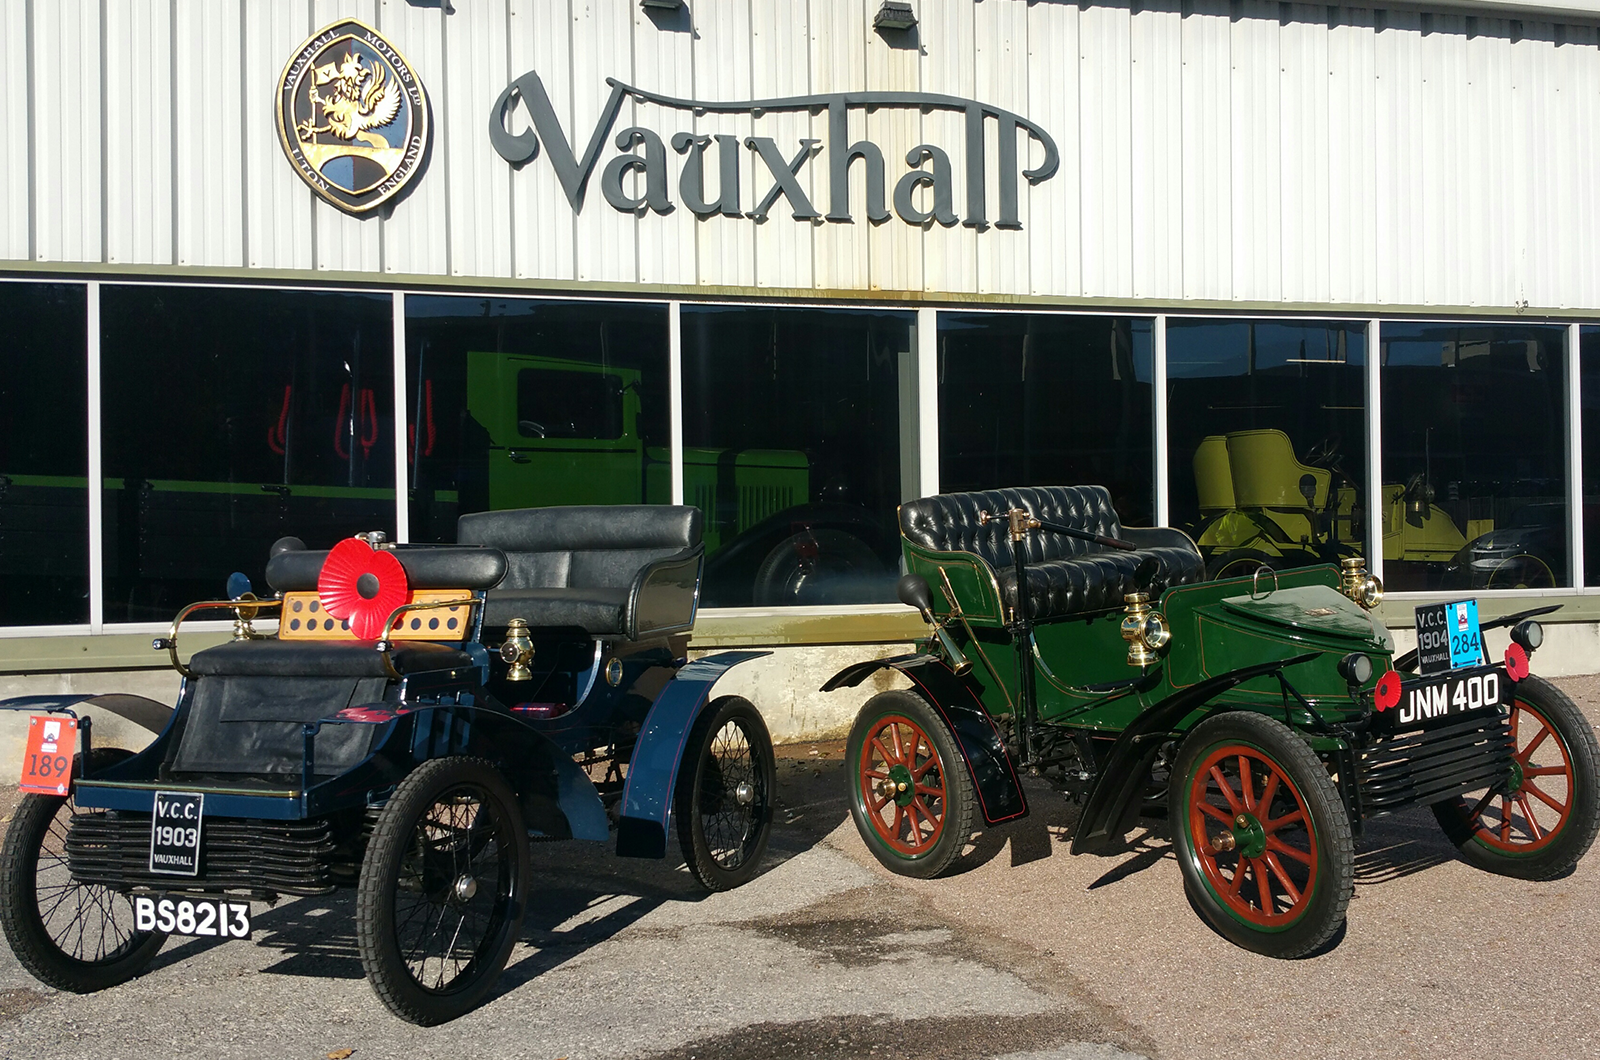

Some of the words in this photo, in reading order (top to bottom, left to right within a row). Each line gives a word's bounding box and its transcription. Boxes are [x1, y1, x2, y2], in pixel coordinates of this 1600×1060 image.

[284, 30, 340, 90] VAUXHALL
[364, 32, 413, 82] MOTORS
[489, 69, 1059, 229] Vauxhall
[377, 135, 421, 195] ENGLAND
[1417, 610, 1447, 629] V.C.C.
[1418, 629, 1448, 650] 1904
[1452, 632, 1479, 656] 284
[1421, 652, 1449, 665] VAUXHALL
[1400, 683, 1448, 723] JNM
[1452, 673, 1499, 711] 400
[29, 754, 68, 777] 189
[158, 801, 198, 819] V.C.C.
[156, 826, 197, 847] 1903
[154, 854, 193, 866] VAUXHALL
[136, 897, 250, 938] BS8213
